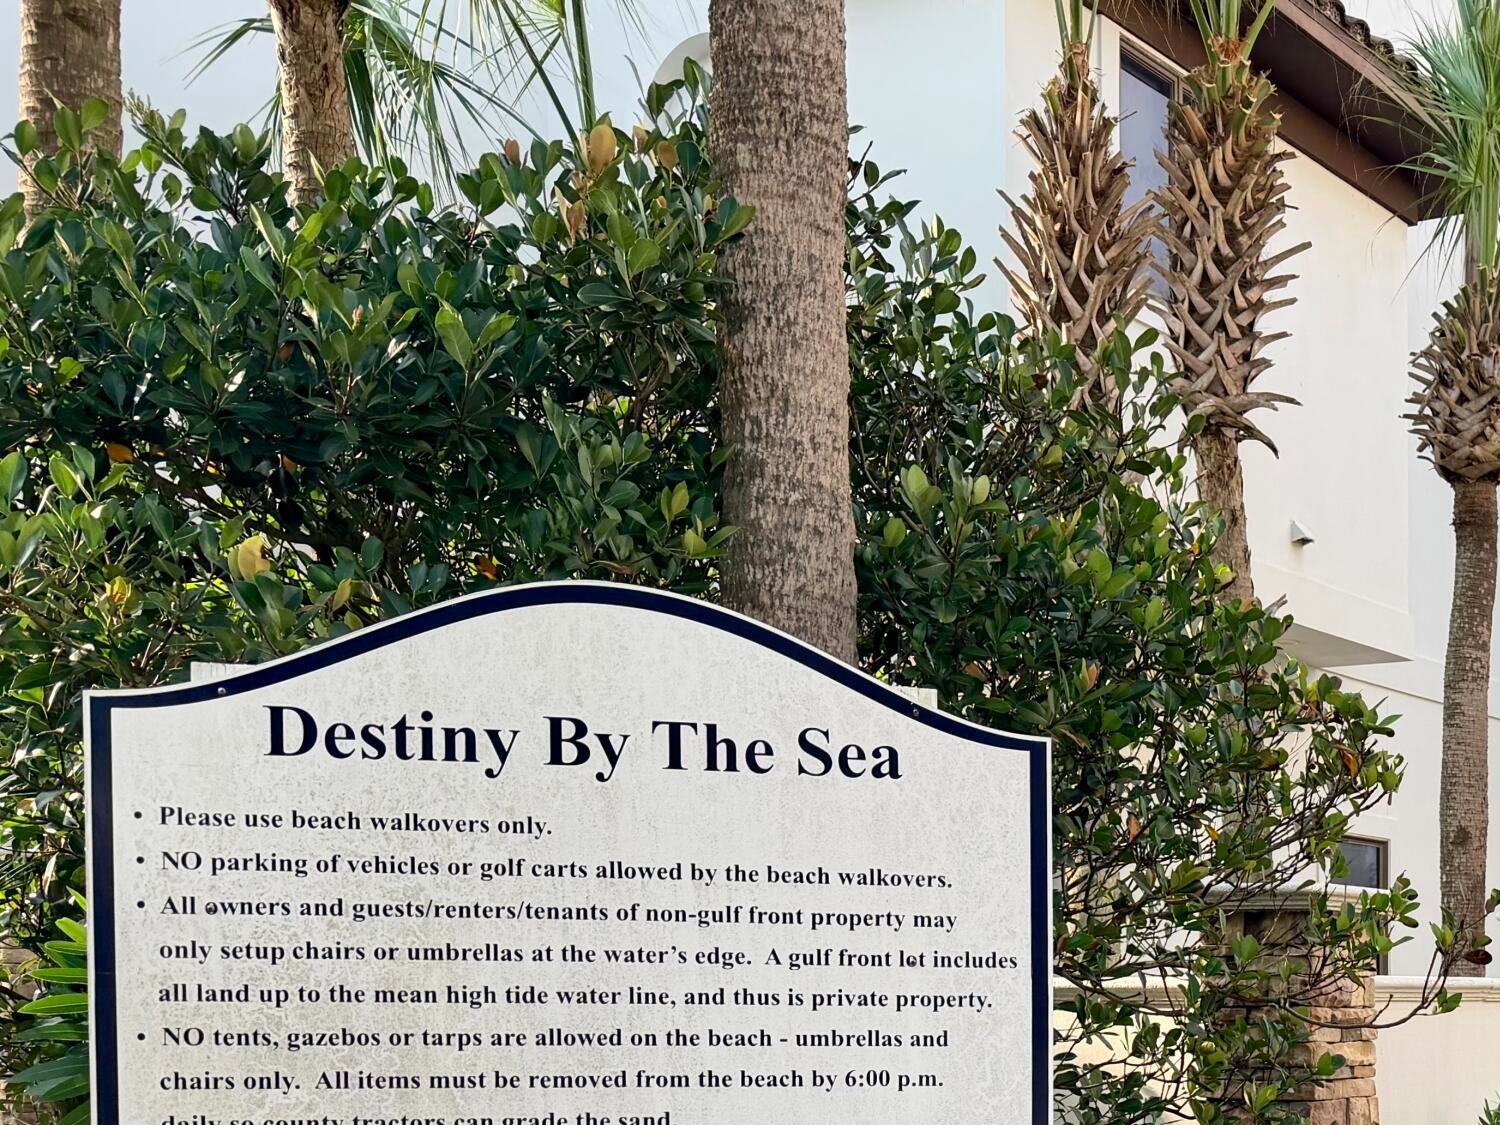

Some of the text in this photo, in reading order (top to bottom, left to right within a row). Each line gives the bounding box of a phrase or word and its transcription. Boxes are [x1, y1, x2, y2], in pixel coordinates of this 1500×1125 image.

[262, 705, 903, 783] Destiny By The Sea
[160, 806, 552, 840] Please use beach walkovers only.
[162, 851, 953, 889] NO parking of vehicles or golf carts allowed by the beach walkovers.
[160, 895, 959, 937] All owners and guests/renters/tenants of non-gulf front property may
[159, 940, 211, 965] only
[220, 942, 285, 966] setup
[292, 940, 366, 961] chairs
[373, 947, 400, 961] or
[407, 942, 524, 962] umbrellas
[531, 945, 554, 962] at
[561, 944, 596, 963] the
[695, 946, 752, 970] edge.
[764, 947, 782, 966] A
[788, 948, 833, 971] gulf
[838, 948, 892, 967] front
[899, 949, 926, 968] lot
[933, 950, 1018, 969] includes
[158, 983, 992, 1013] all land up to the mean high tide water line, and thus is private property.
[162, 1027, 205, 1047] NO
[213, 1028, 279, 1051] tents,
[287, 1027, 381, 1053] gazebos
[388, 1032, 415, 1047] or
[421, 1029, 482, 1052] tarps
[490, 1033, 527, 1047] are
[535, 1027, 623, 1047] allowed
[630, 1033, 658, 1047] on
[665, 1028, 700, 1047] the
[708, 1028, 772, 1047] beach
[795, 1029, 903, 1048] umbrellas
[910, 1029, 949, 1048] and
[159, 1069, 944, 1096] chairs only. All items must be removed from the beach by 6:00 p.m.
